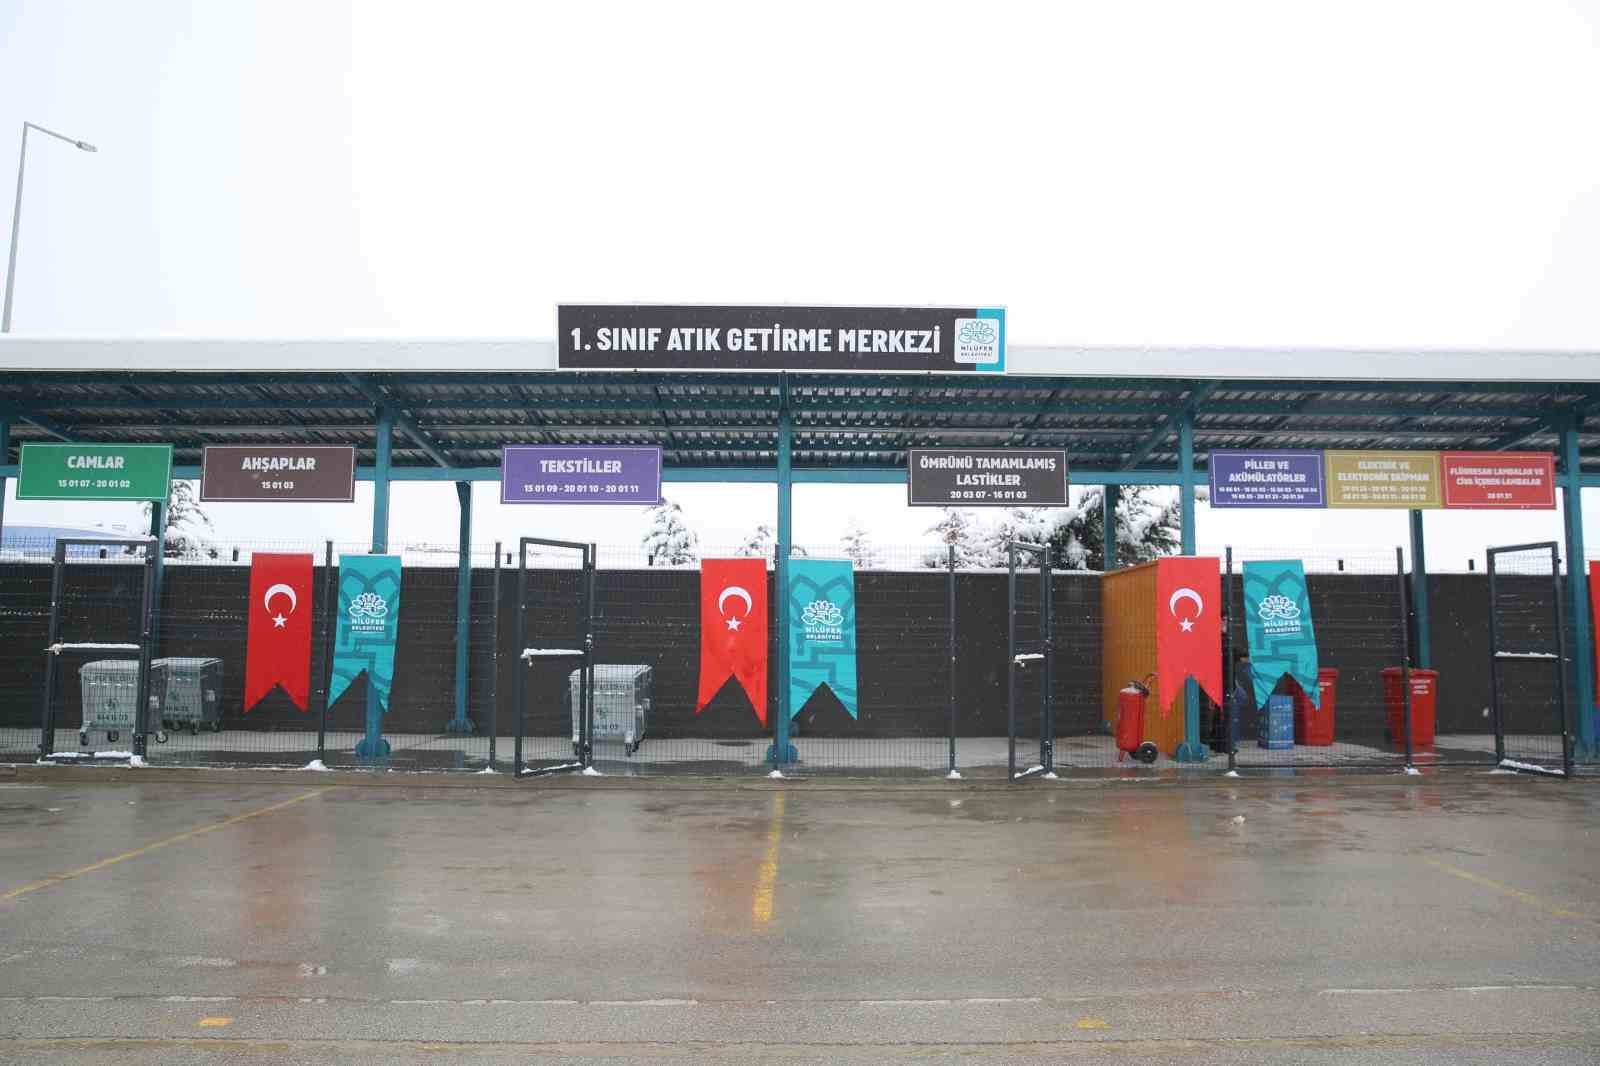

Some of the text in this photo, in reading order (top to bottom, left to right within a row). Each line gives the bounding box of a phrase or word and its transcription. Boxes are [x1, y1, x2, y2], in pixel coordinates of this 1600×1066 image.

[571, 323, 941, 354] 1. SINIF ATIK GETİRME MERKEZİ
[67, 456, 125, 469] CAMLAR
[241, 457, 316, 472] AHŞAPLAR
[540, 458, 622, 473] TEKSTİLLER
[920, 456, 1056, 471] ÖMRÜNÜ TAMAMLAMIŞ
[1244, 459, 1289, 470] PİLLER VE
[58, 479, 67, 488] 15
[68, 479, 78, 488] 01
[80, 479, 90, 488] 07
[96, 479, 107, 488] 20
[108, 479, 118, 488] 01
[120, 479, 130, 488] 02
[956, 472, 1021, 485] LASTİKLER
[1228, 472, 1306, 482] AKÜMÜLATÖRLER
[262, 481, 294, 489] 15 01 03
[524, 484, 533, 493] 15
[534, 484, 544, 493] 01
[547, 484, 558, 493] 09
[565, 484, 575, 493] 20
[577, 484, 587, 493] 01
[589, 484, 598, 493] 10
[606, 484, 616, 493] 20
[618, 484, 628, 493] 01
[630, 484, 639, 493] 11
